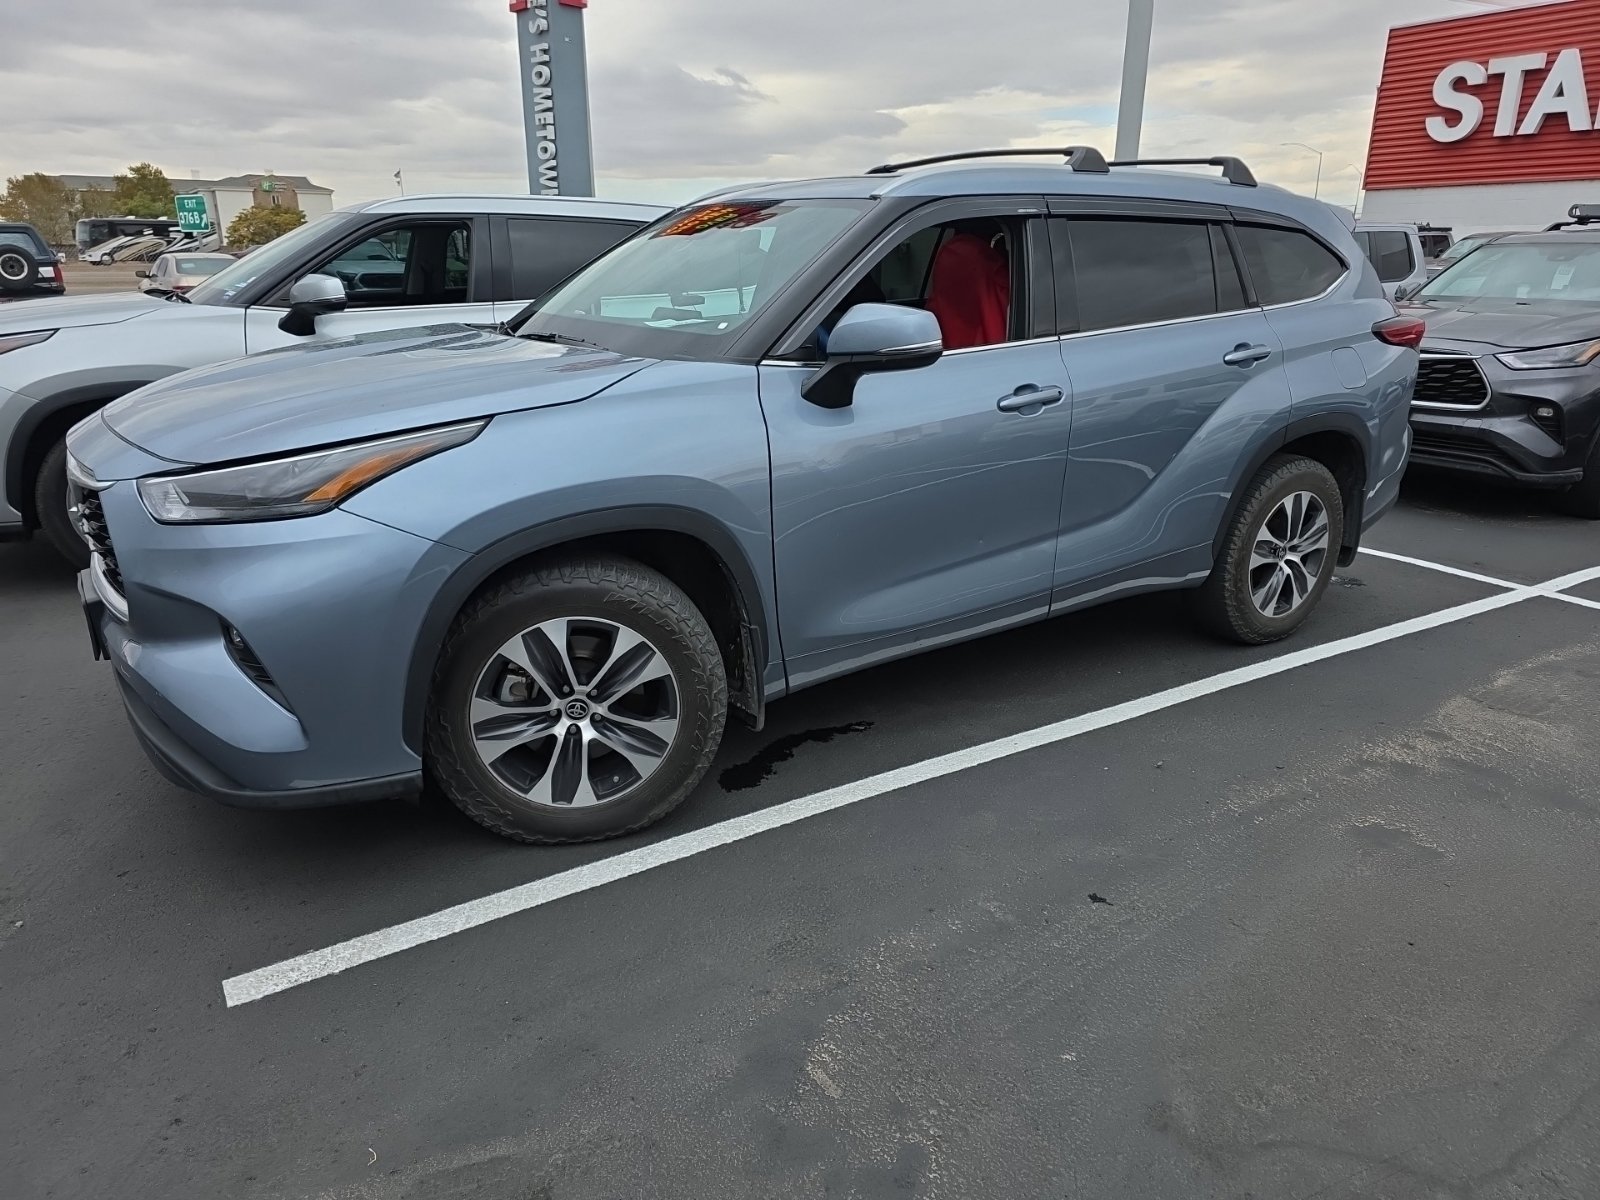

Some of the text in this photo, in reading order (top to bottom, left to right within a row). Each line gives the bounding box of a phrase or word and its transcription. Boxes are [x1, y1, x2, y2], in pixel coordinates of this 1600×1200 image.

[1425, 48, 1600, 143] STA
[184, 199, 197, 208] EXIT
[180, 211, 200, 224] 376B
